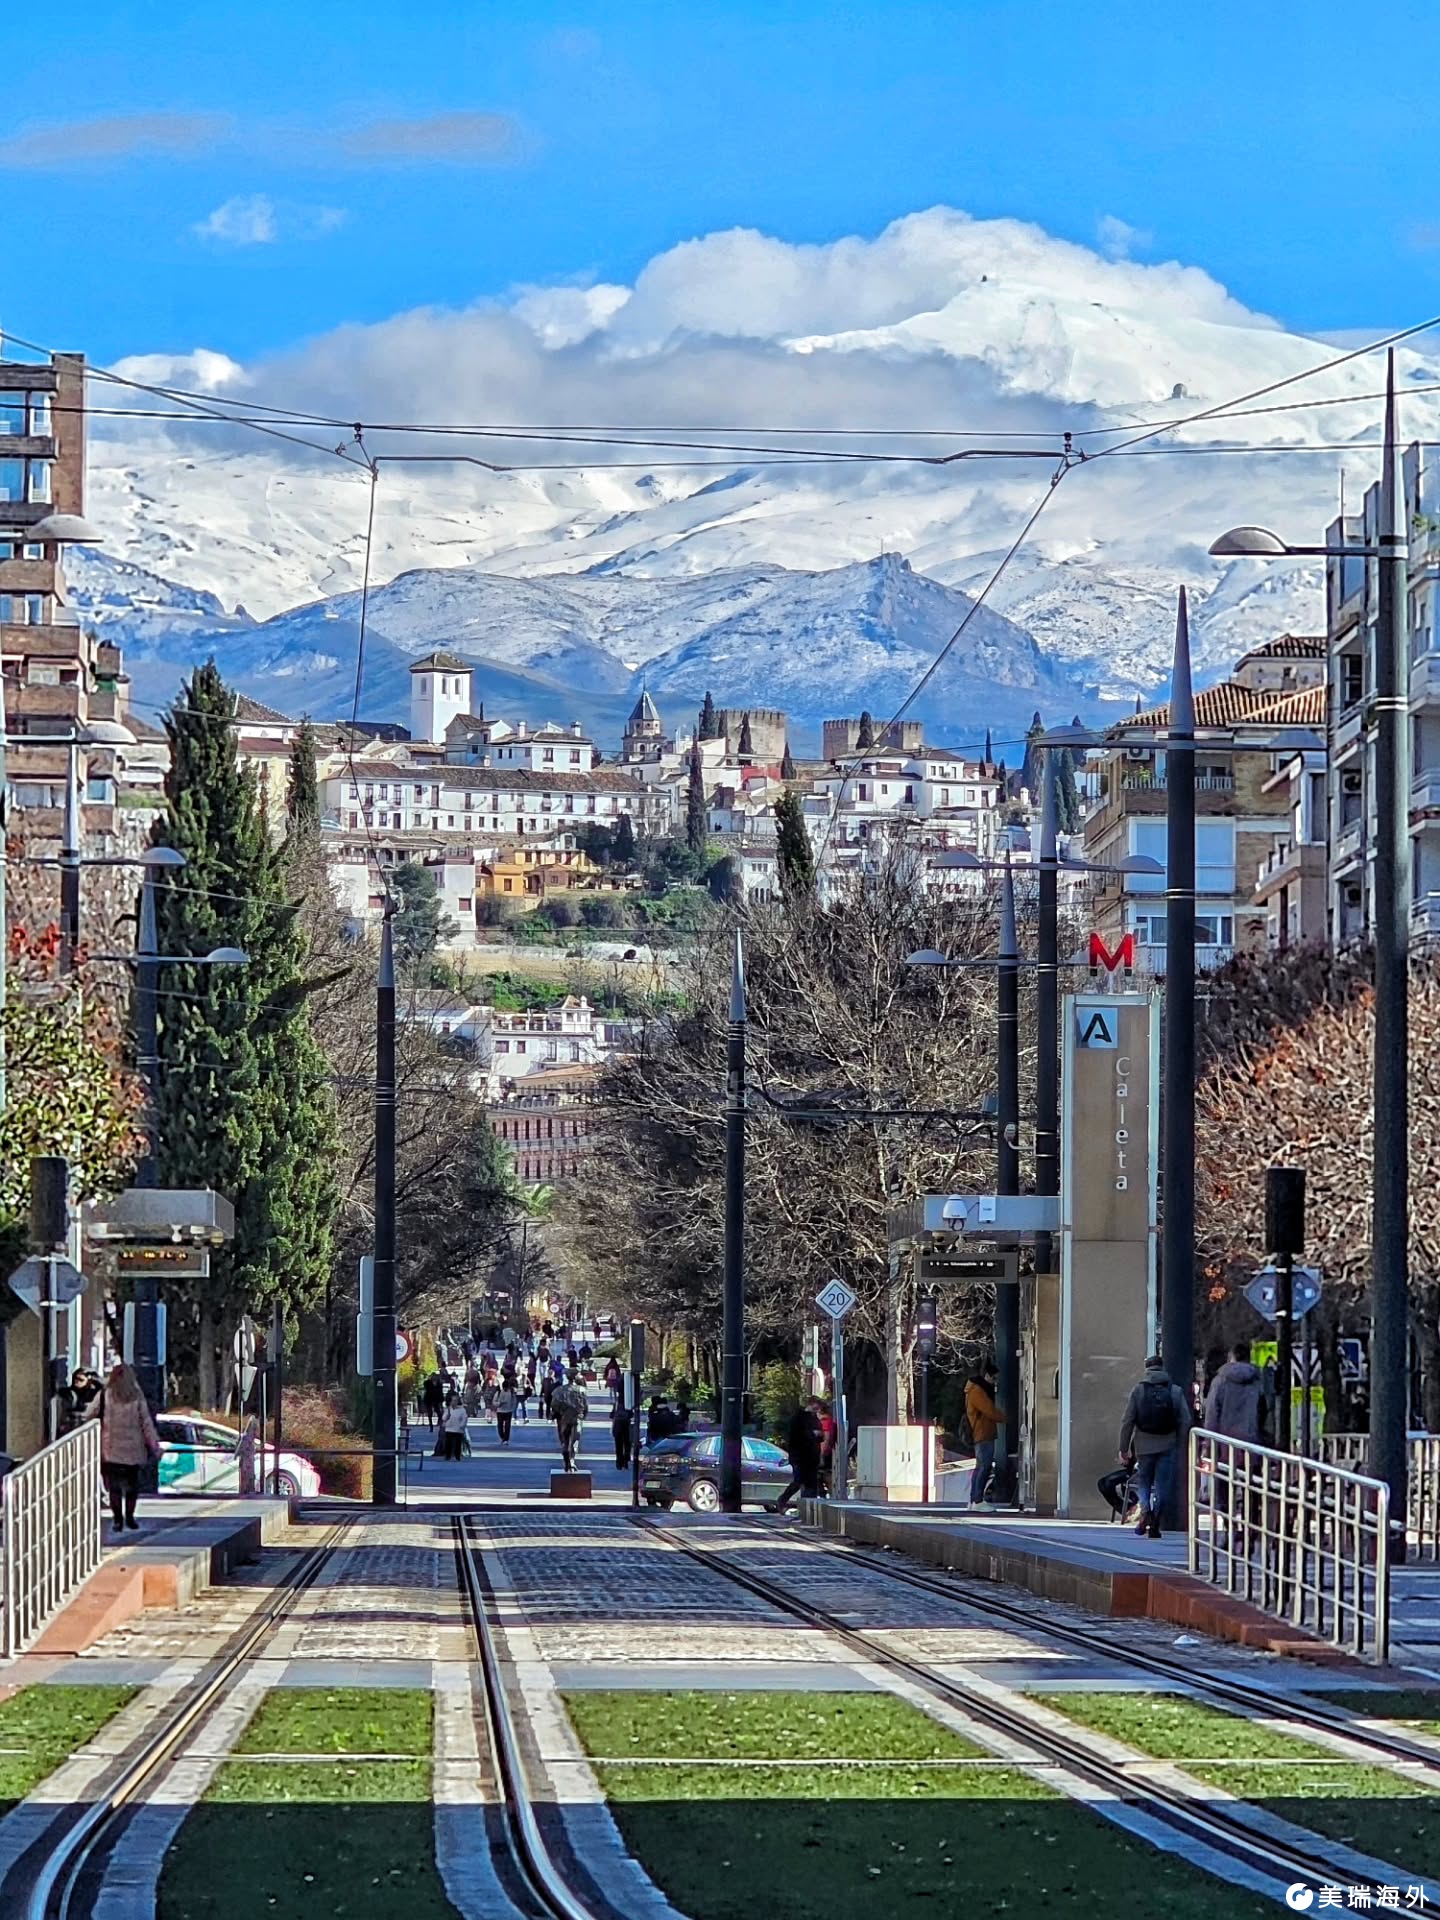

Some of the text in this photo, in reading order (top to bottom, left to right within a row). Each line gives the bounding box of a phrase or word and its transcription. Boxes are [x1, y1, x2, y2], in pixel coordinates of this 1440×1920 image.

[1089, 932, 1134, 972] M
[1081, 1013, 1113, 1043] A
[1115, 1056, 1131, 1191] Caleta
[827, 1293, 845, 1306] 20
